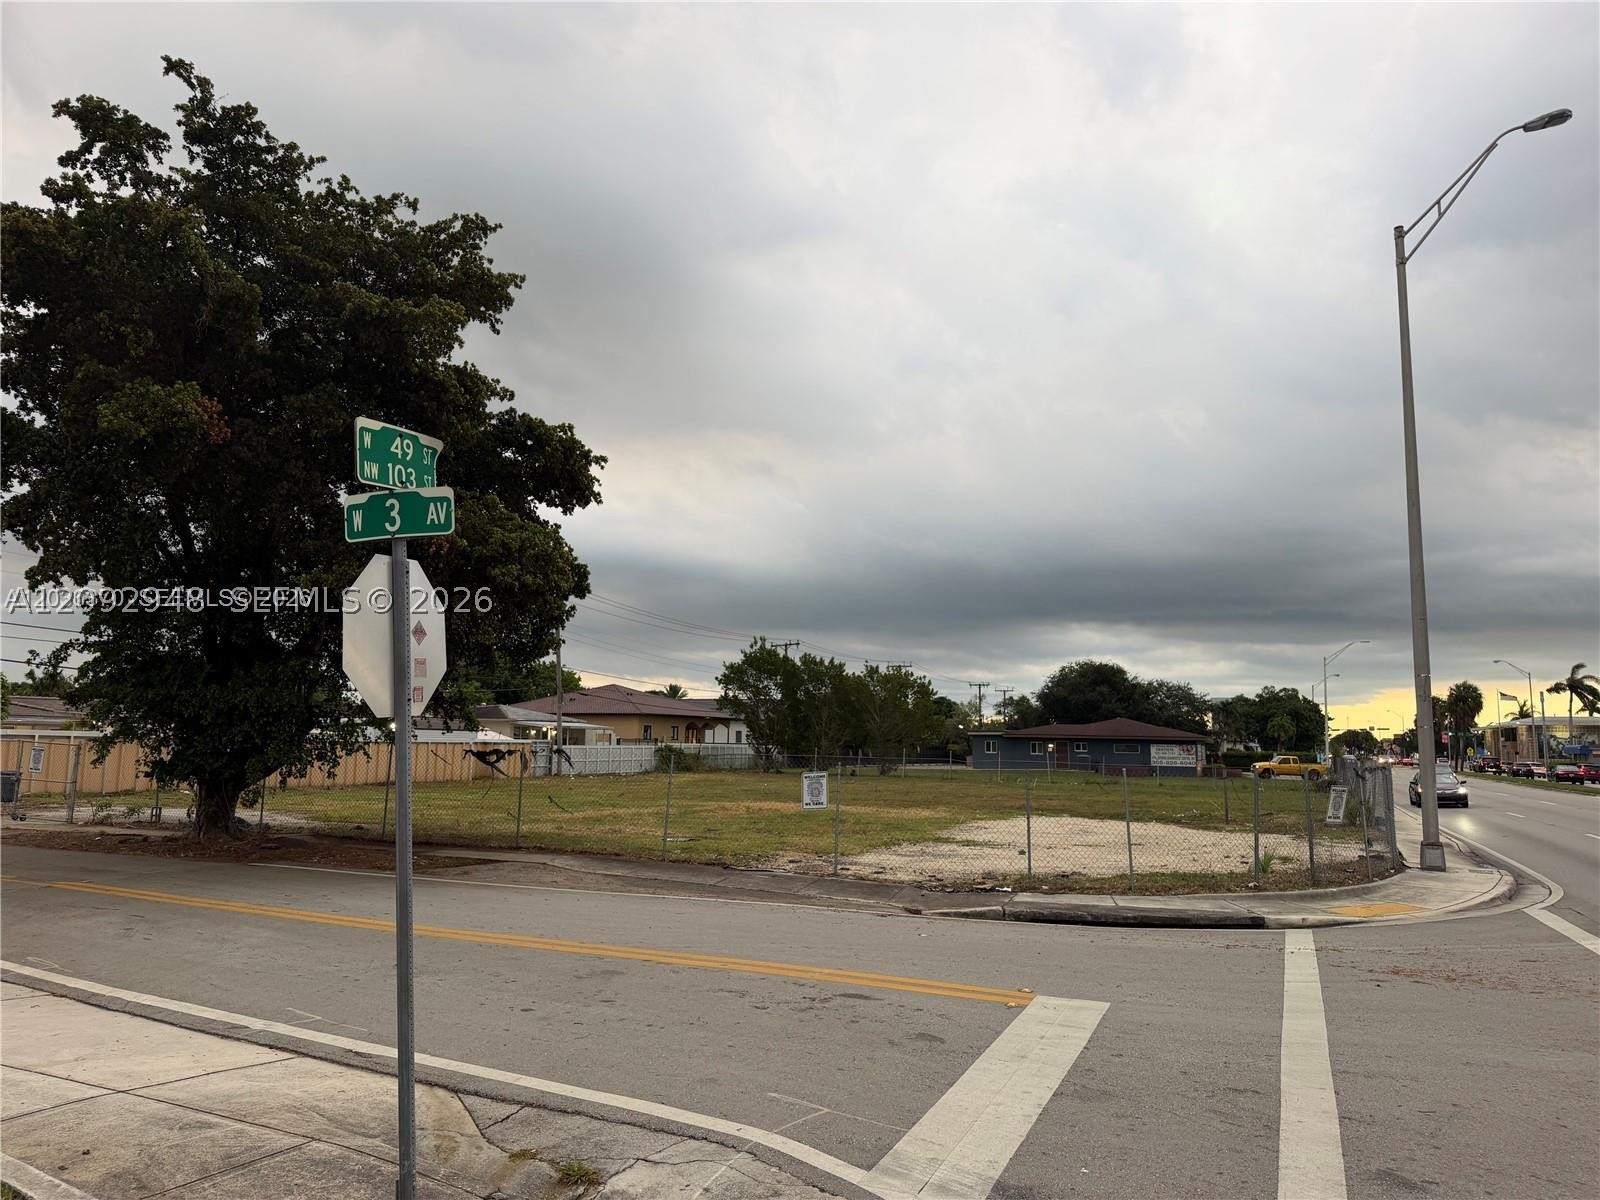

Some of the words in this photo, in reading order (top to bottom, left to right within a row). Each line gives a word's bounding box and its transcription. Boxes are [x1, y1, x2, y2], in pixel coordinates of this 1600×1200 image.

[363, 431, 372, 449] W
[390, 436, 414, 461] 49
[423, 447, 433, 465] ST
[364, 460, 379, 480] NW
[387, 462, 417, 489] 103
[424, 475, 432, 488] ST
[352, 509, 363, 532] W
[384, 498, 401, 532] 3
[426, 502, 447, 525] AV
